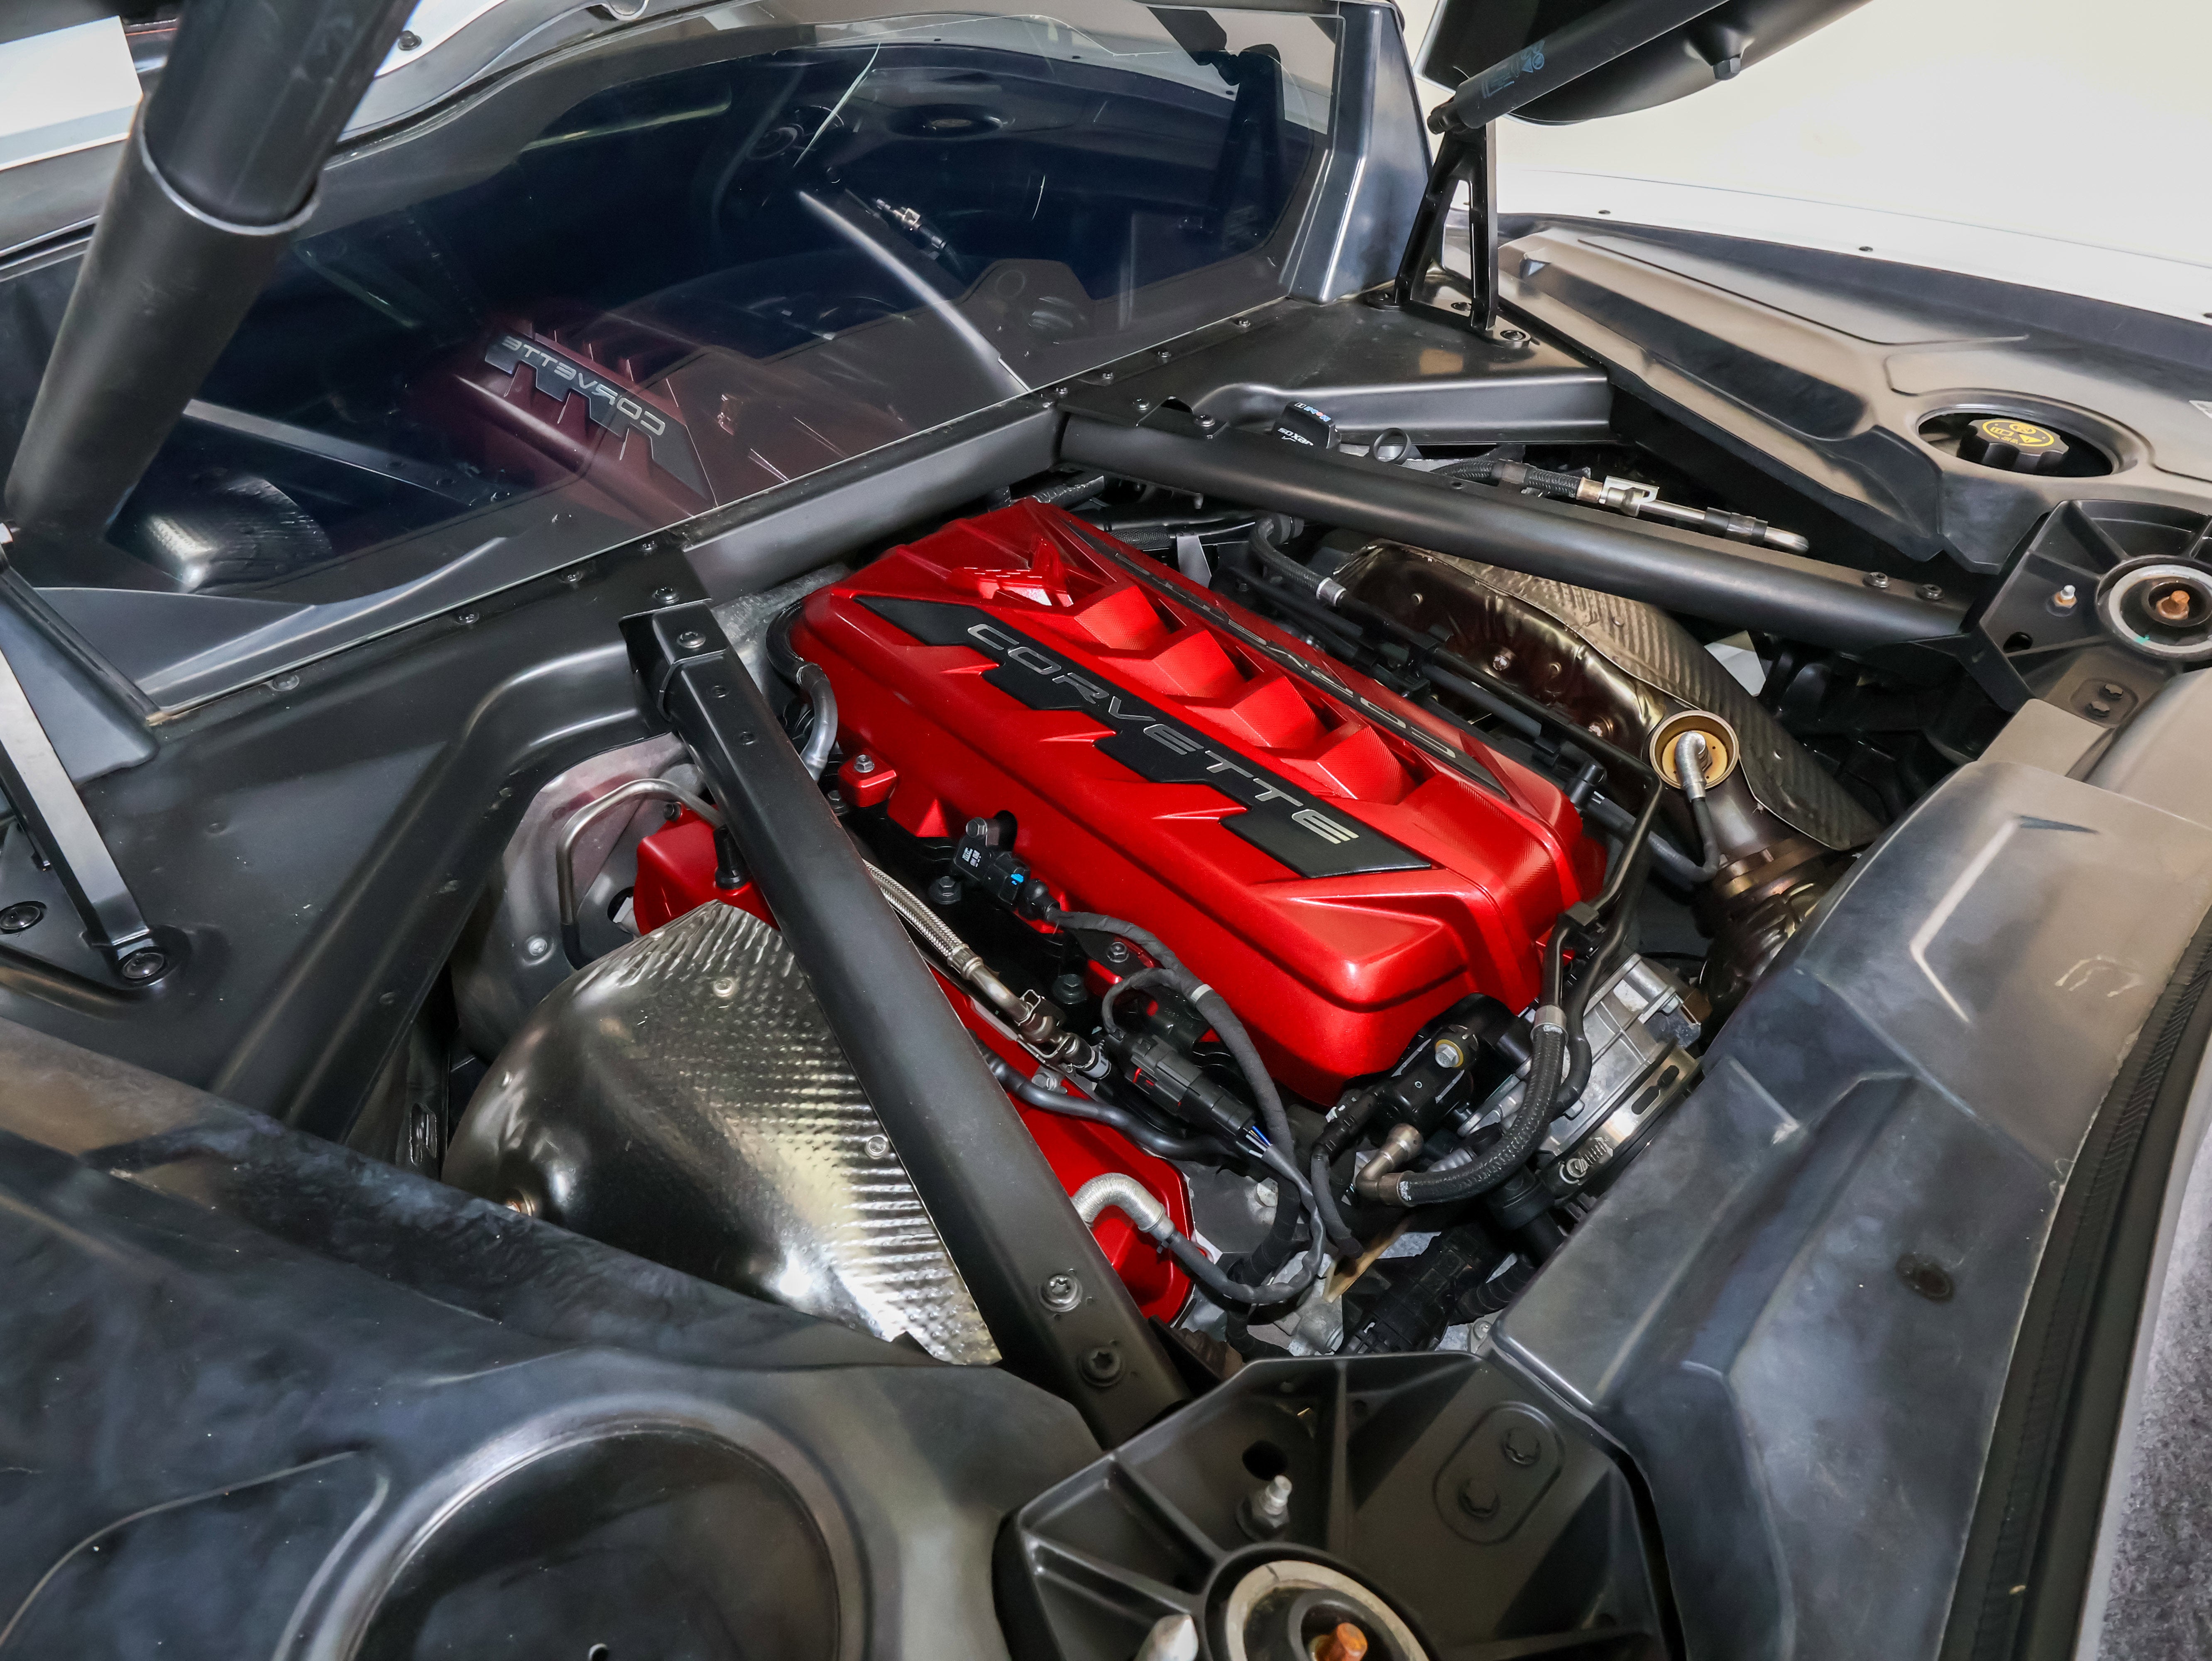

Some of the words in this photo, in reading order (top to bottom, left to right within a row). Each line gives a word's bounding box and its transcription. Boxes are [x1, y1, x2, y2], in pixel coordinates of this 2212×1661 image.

[1303, 406, 1331, 422] Mobil
[967, 623, 1360, 844] CORVETTE
[1115, 552, 1456, 759] CORVETTE
